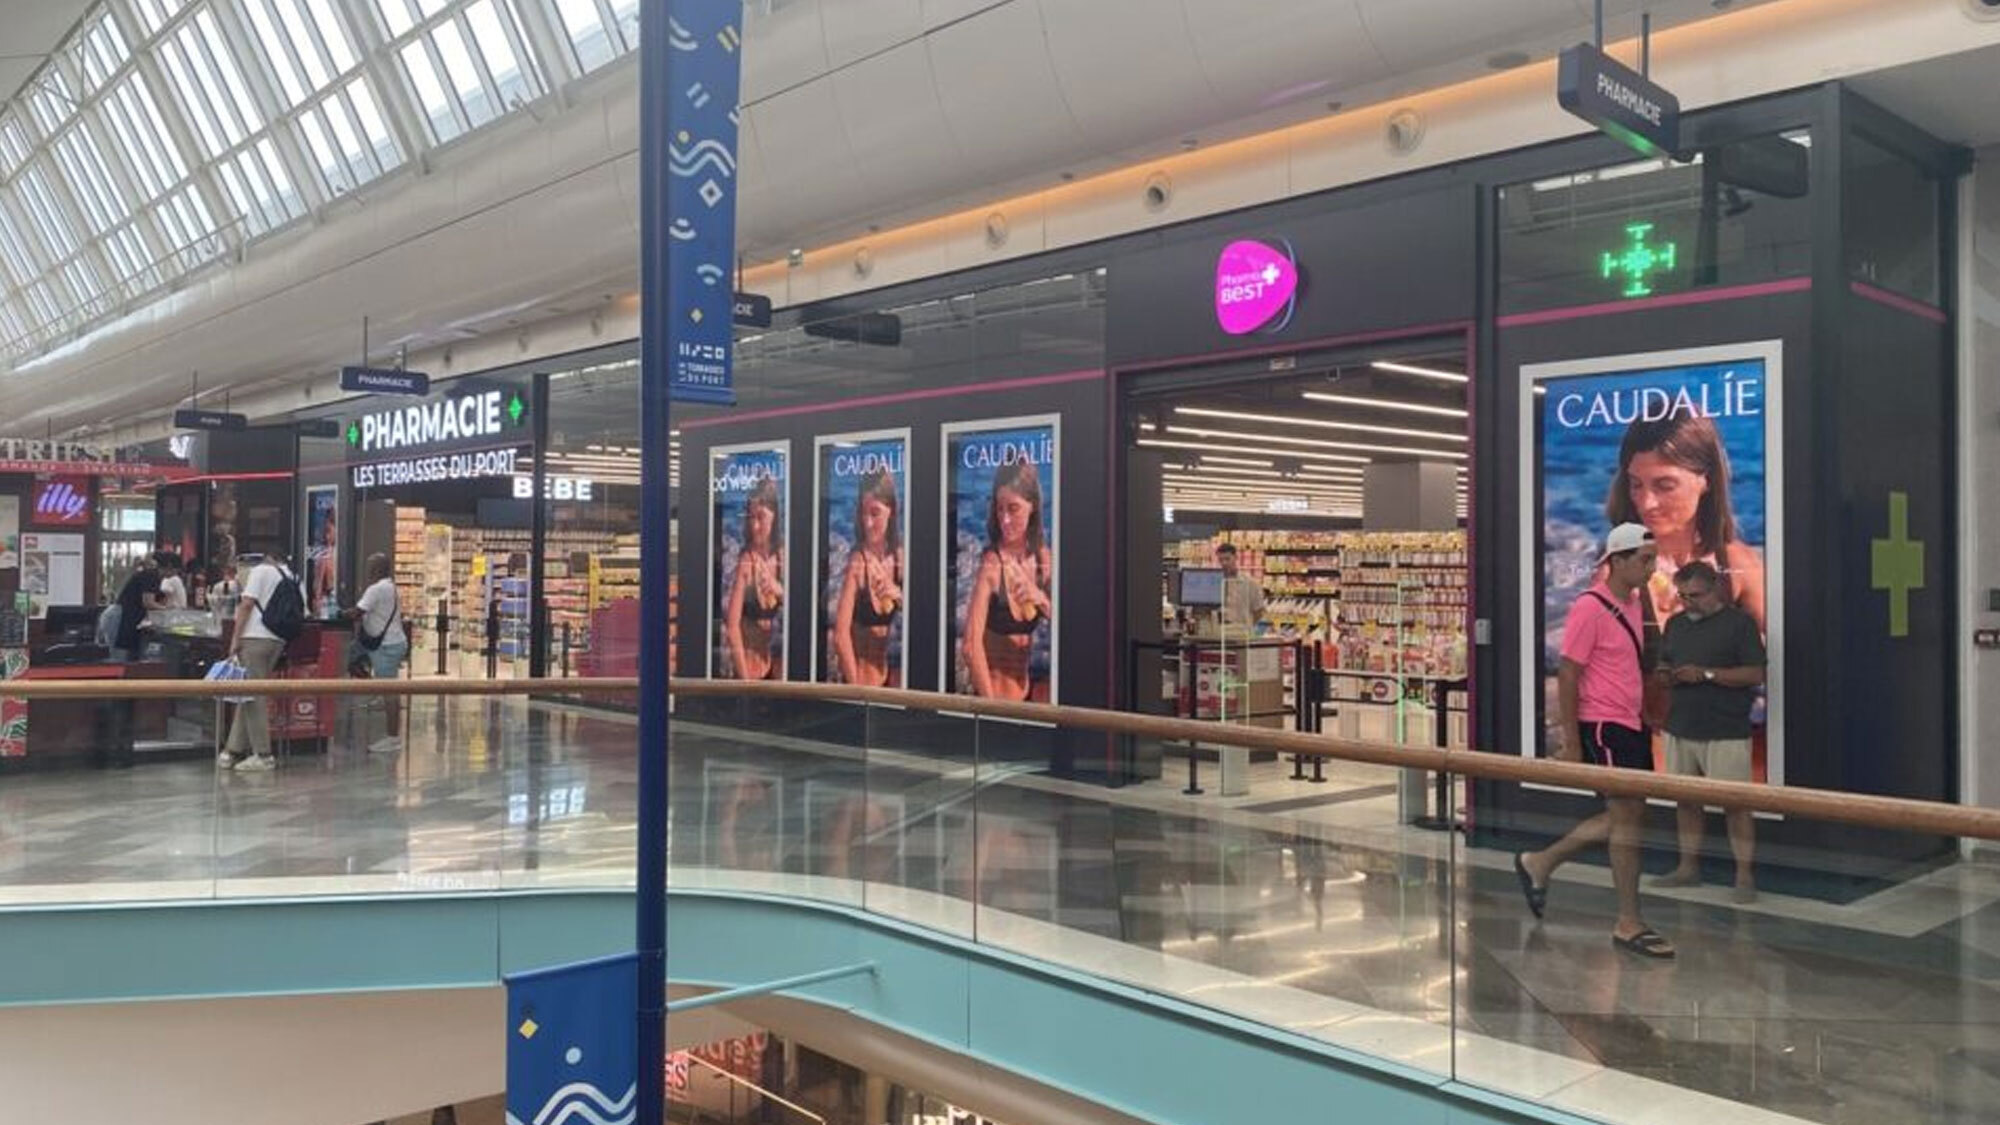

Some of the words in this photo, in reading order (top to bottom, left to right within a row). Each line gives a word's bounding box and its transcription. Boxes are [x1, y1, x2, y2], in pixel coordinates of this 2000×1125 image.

[1597, 72, 1661, 126] PHARMACIE
[358, 375, 413, 389] PHARMACIE
[362, 391, 502, 451] PHARMACIE
[354, 466, 375, 488] LES
[376, 456, 448, 486] TERRASSES
[450, 453, 472, 479] DU
[473, 448, 518, 477] PORT
[37, 483, 88, 522] illy
